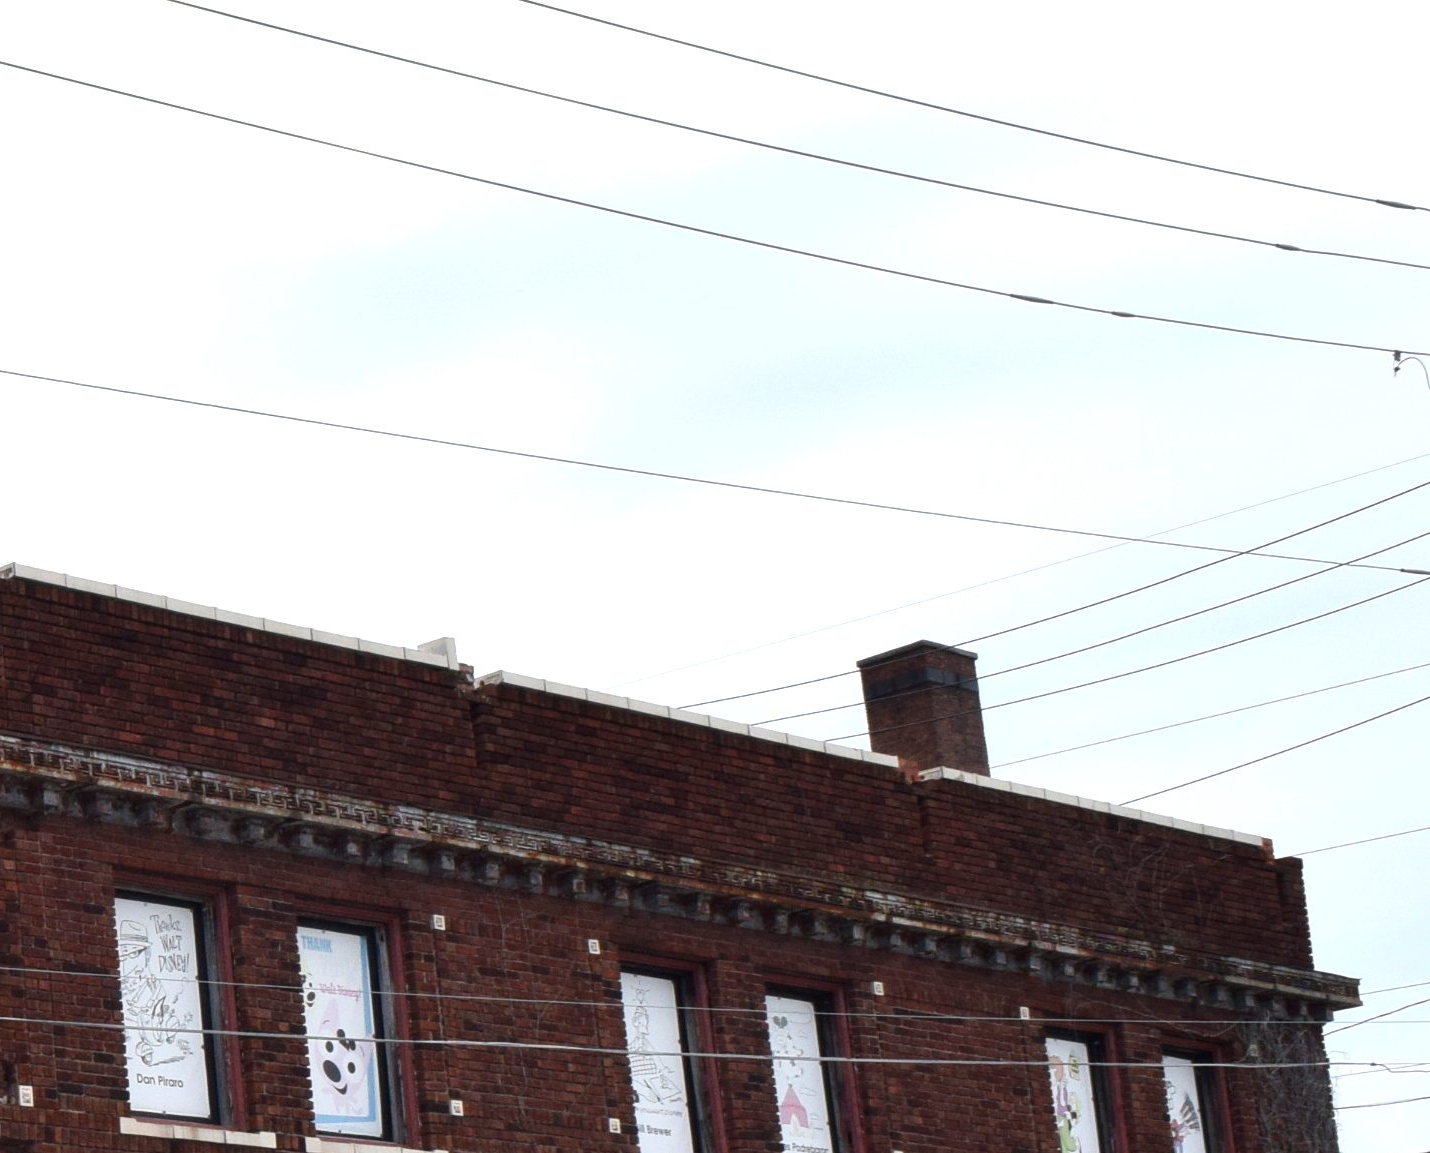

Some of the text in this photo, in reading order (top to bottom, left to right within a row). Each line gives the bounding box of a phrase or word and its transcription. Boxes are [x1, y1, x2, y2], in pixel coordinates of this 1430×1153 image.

[301, 935, 333, 953] THANK
[136, 1073, 184, 1088] Dan Piraro
